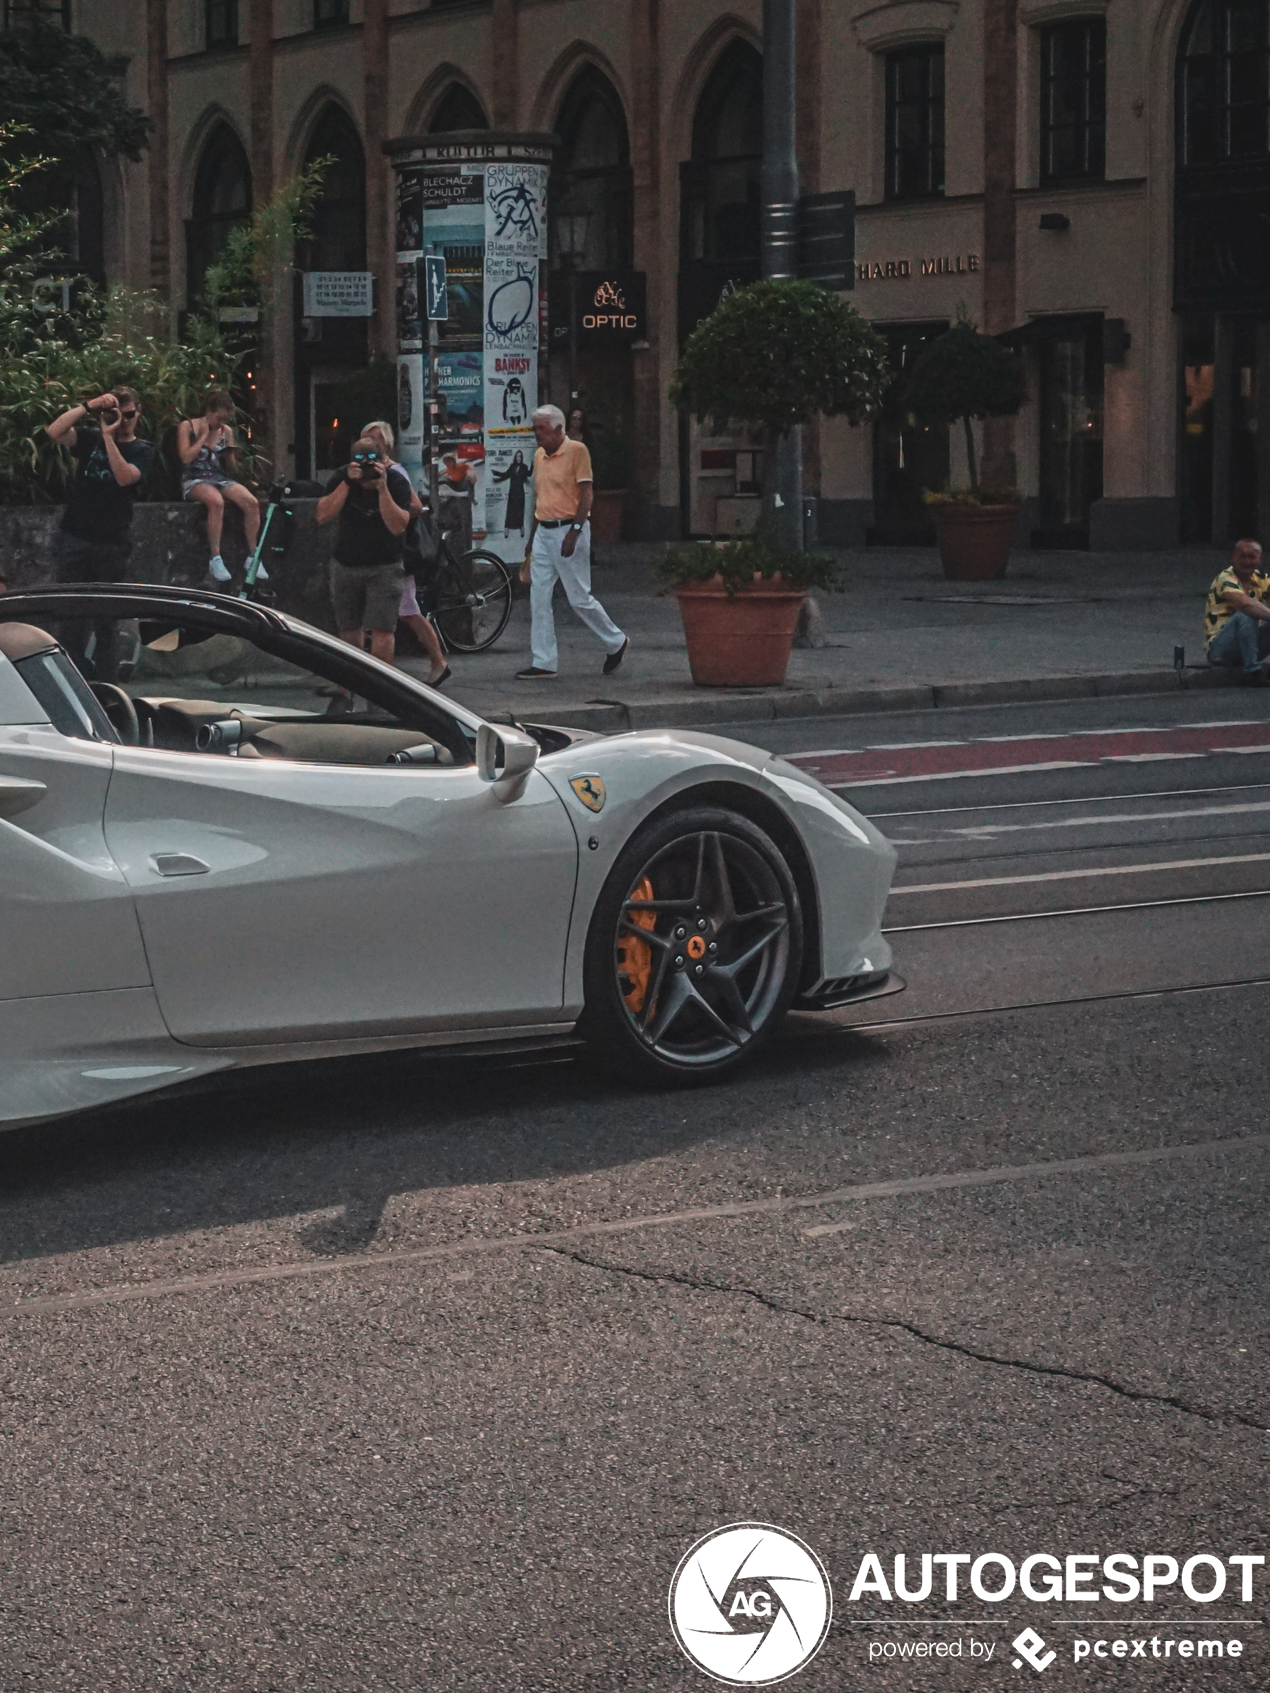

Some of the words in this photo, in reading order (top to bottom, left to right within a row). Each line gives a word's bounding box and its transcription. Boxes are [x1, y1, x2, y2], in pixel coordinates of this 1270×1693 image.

[487, 165, 538, 176] GRUPPEN
[423, 175, 473, 186] BLECHACZ
[487, 176, 538, 187] DYNAMIK
[423, 187, 467, 198] SCHULDT
[487, 241, 514, 251] Blaue
[486, 257, 504, 267] Der
[856, 260, 912, 280] HARD
[920, 254, 980, 276] MILLE
[486, 267, 514, 277] Reiter
[583, 315, 637, 328] OPTIC
[485, 332, 538, 344] DYNAMIK
[495, 358, 530, 372] BANKSY
